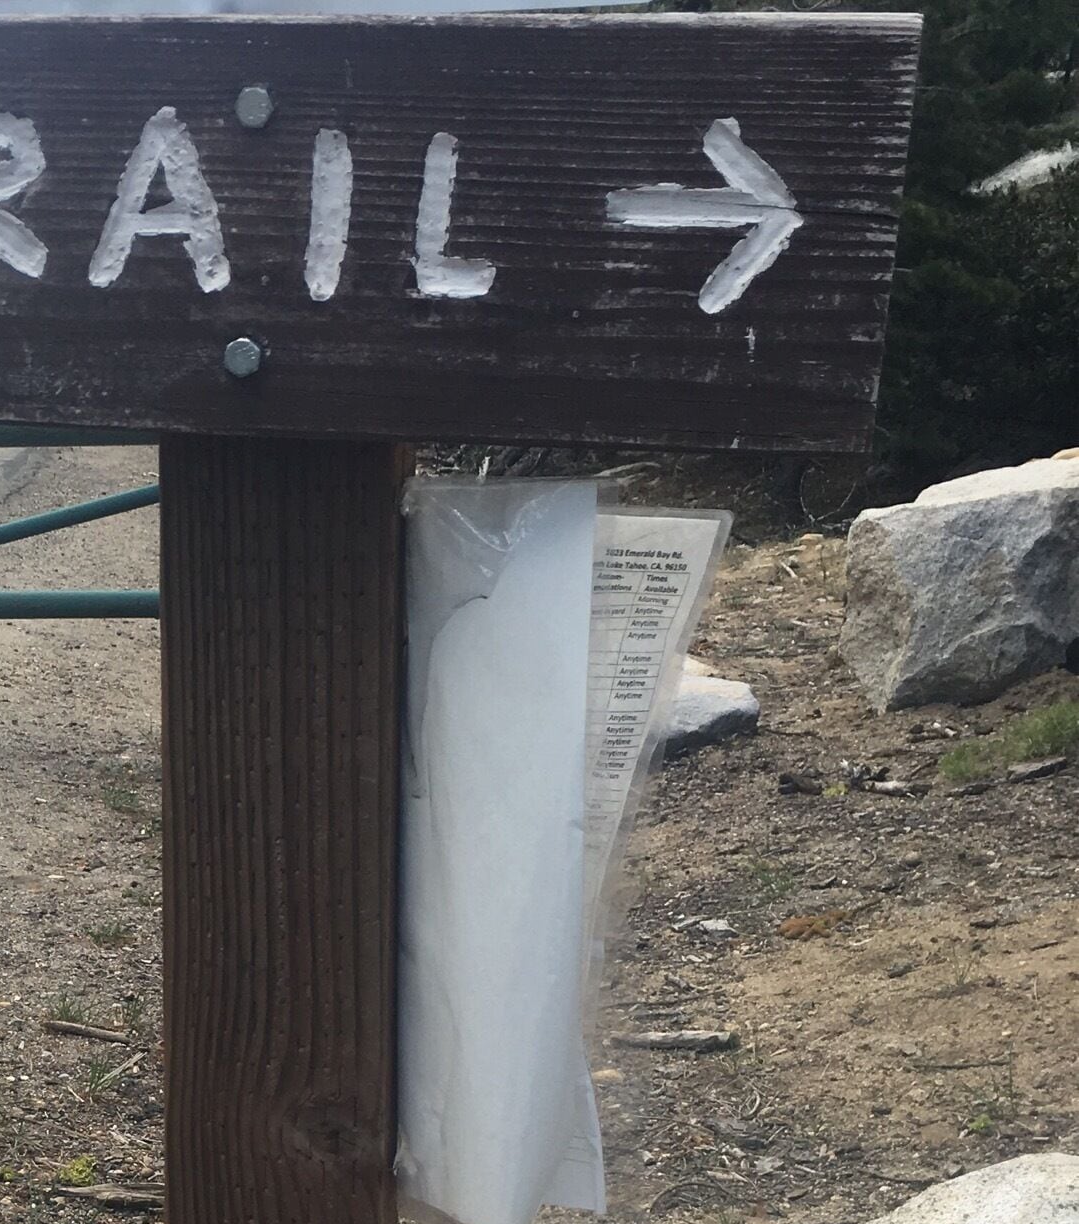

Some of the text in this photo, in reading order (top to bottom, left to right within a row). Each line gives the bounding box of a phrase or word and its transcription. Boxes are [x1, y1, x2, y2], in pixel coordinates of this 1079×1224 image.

[625, 549, 656, 558] Emerald
[656, 551, 671, 559] Bay
[606, 561, 623, 569] Lake
[664, 563, 688, 571] 96150
[646, 574, 668, 582] Times
[644, 585, 679, 594] Available
[638, 596, 669, 605] Morning
[634, 607, 664, 615] Anytime
[628, 632, 657, 640] Anytime
[622, 655, 652, 663] Anytime
[619, 667, 649, 676] Anytime
[617, 680, 646, 688] Anytime
[614, 692, 643, 700] Anytime
[608, 714, 638, 722] Anytime
[606, 726, 635, 735] Anytime
